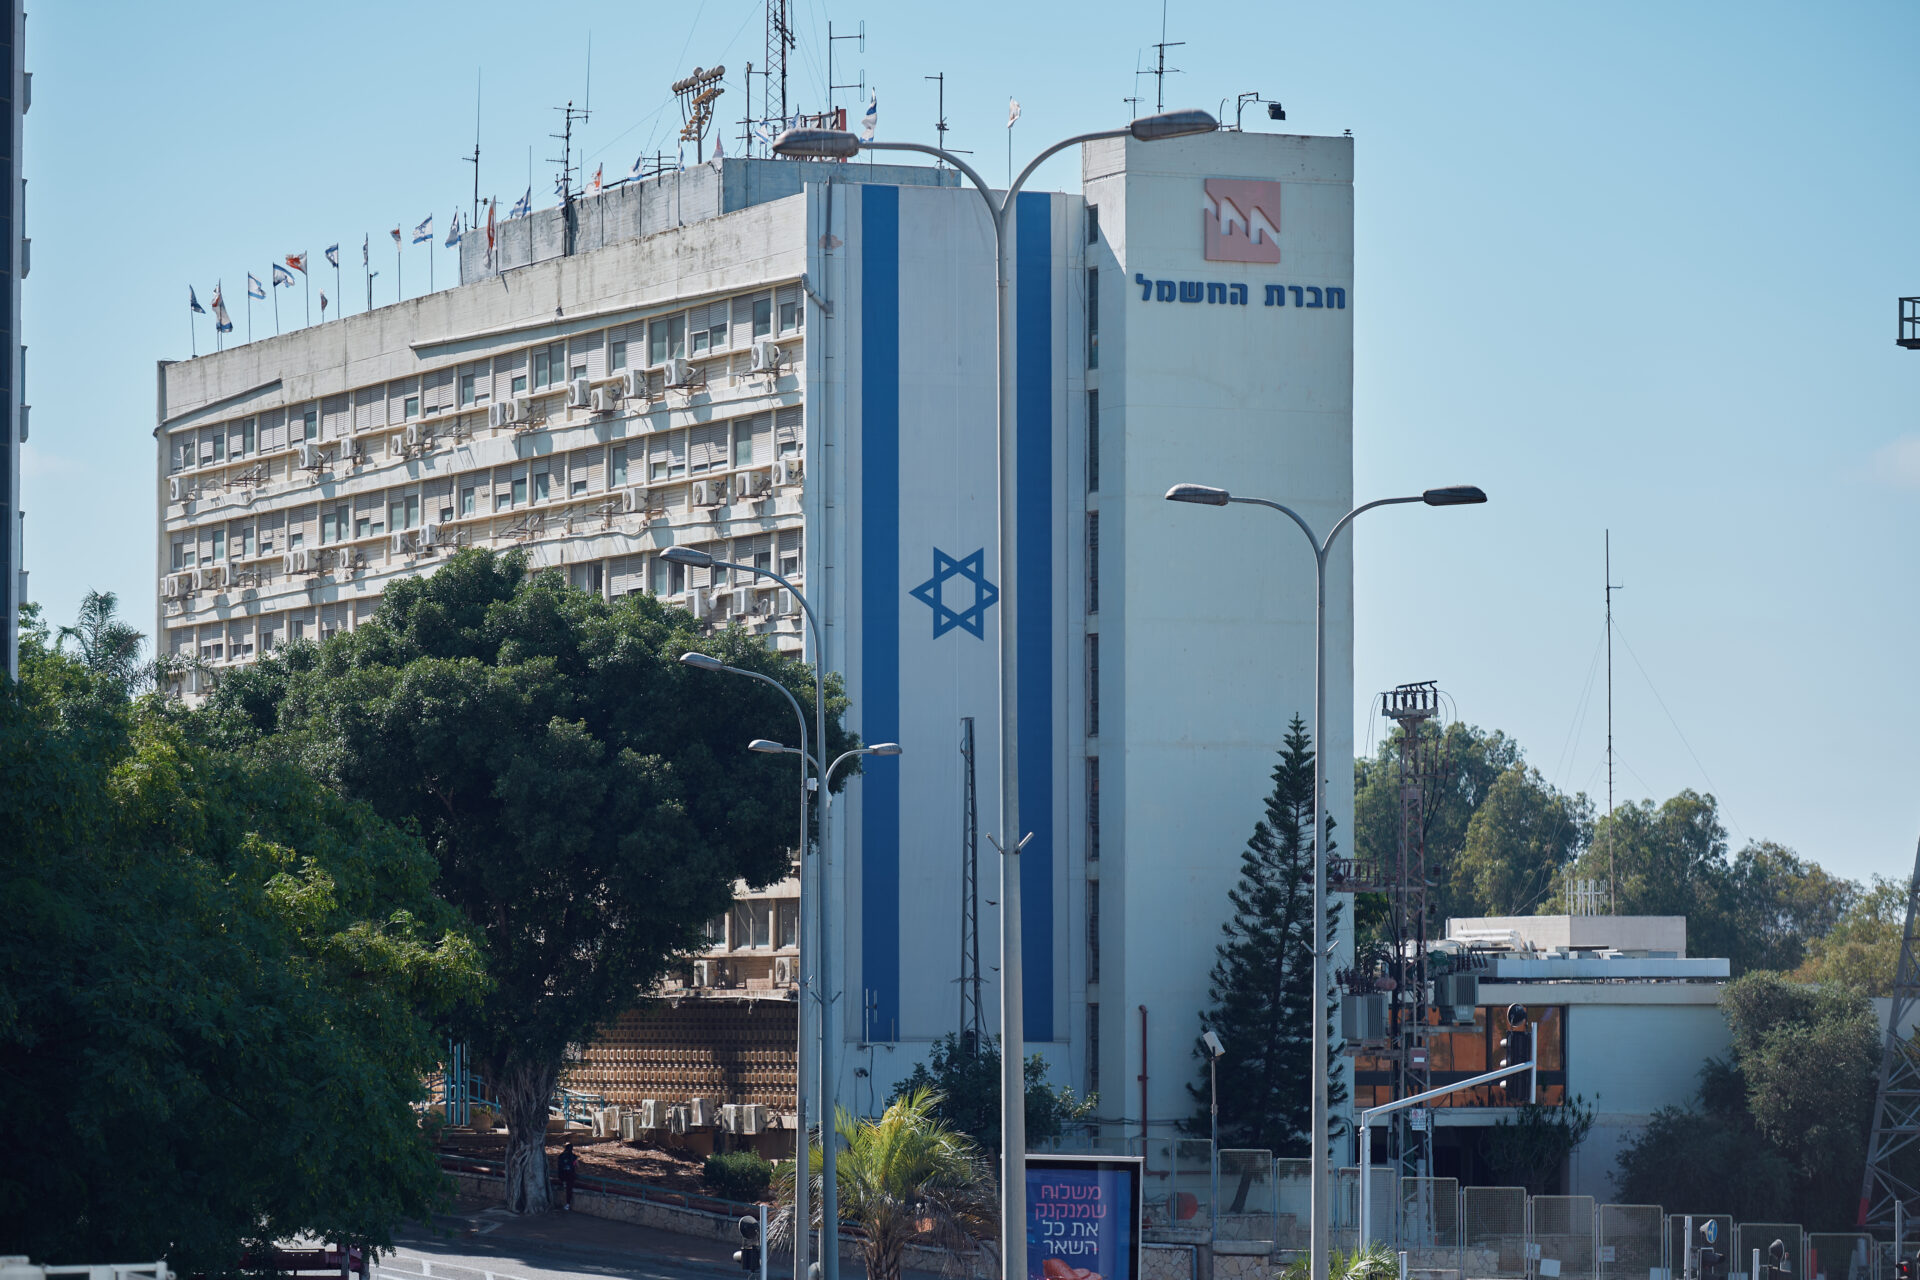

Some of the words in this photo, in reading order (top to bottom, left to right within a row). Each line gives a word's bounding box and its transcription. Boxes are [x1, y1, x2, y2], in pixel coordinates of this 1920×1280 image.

[1135, 273, 1249, 306] החשמל
[1264, 284, 1346, 310] חברת
[1041, 1184, 1102, 1200] משלוח
[1035, 1203, 1107, 1221] שמנקנק
[1042, 1219, 1065, 1236] כל
[1071, 1222, 1099, 1237] את
[1043, 1240, 1097, 1255] השאר
